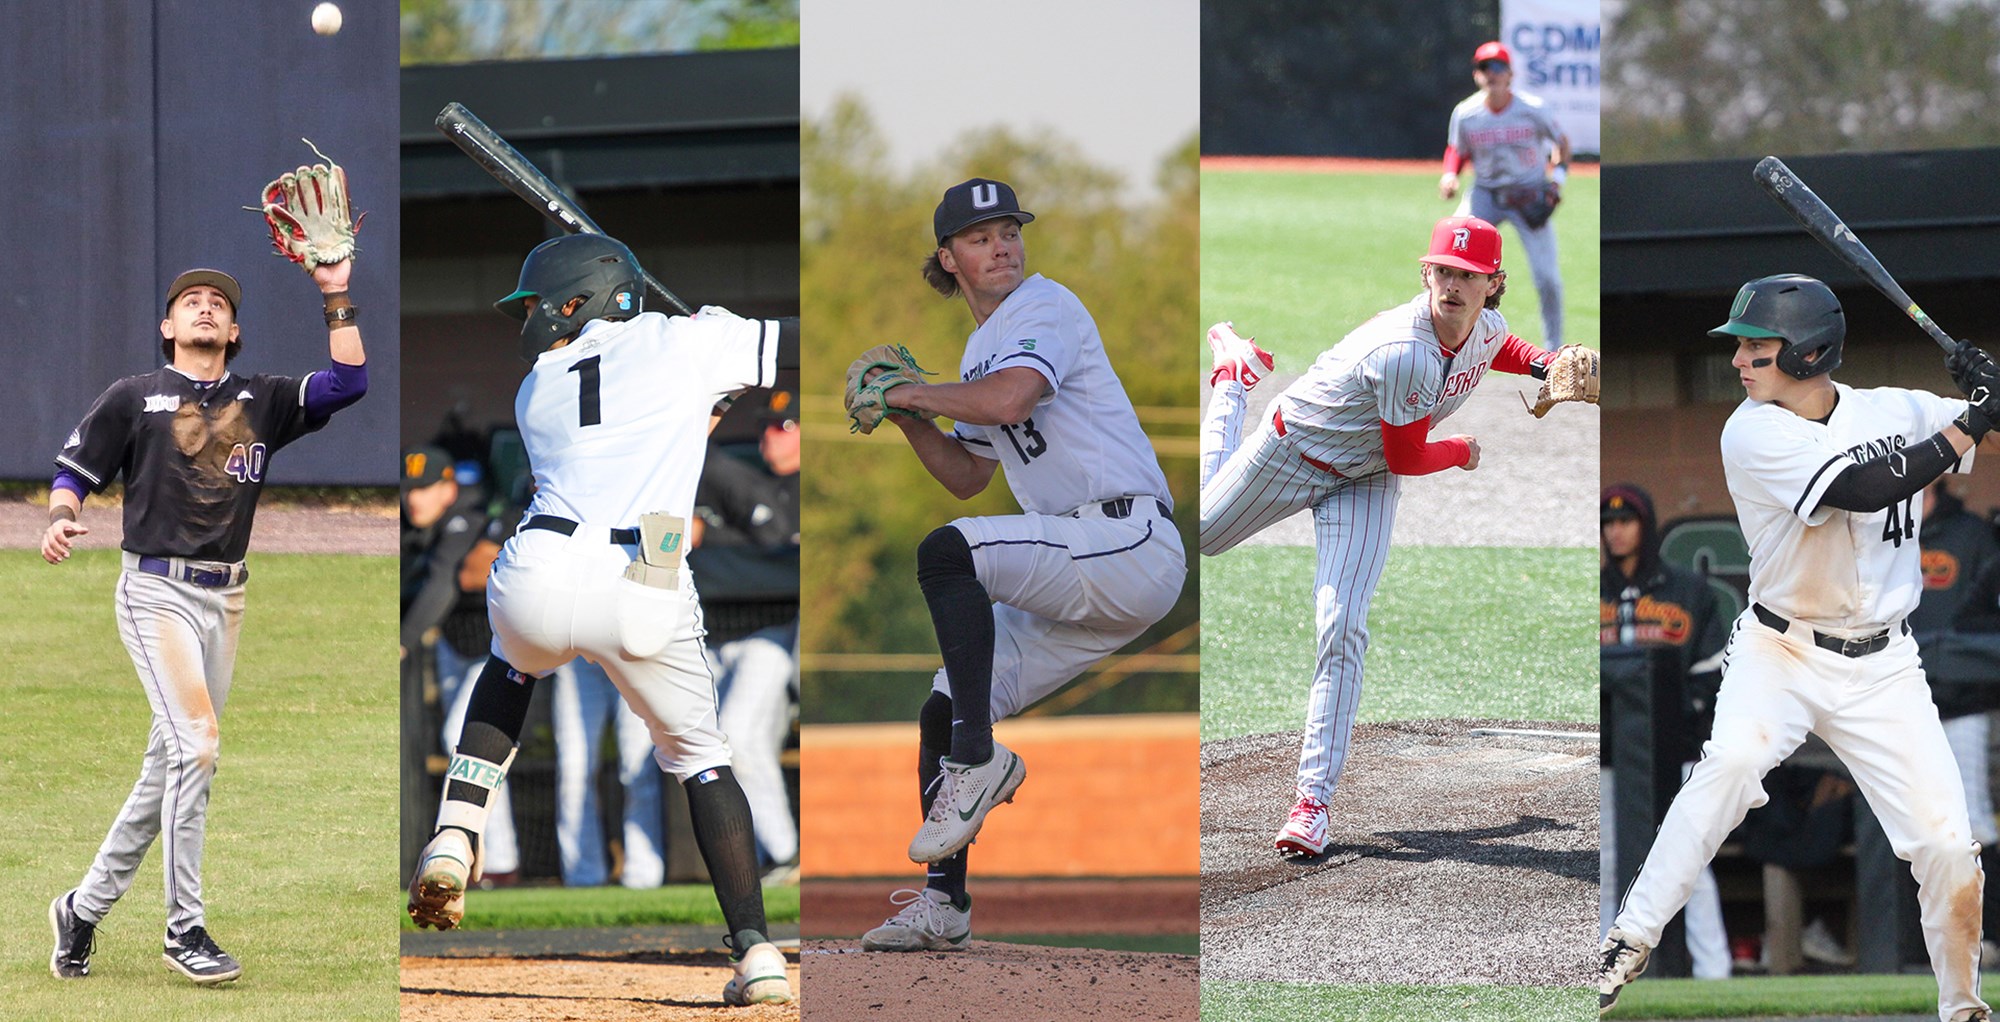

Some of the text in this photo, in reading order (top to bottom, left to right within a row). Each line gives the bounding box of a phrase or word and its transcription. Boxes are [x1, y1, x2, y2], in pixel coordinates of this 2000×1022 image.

[971, 183, 1000, 210] U
[1452, 227, 1471, 252] R
[1729, 283, 1756, 321] U
[567, 354, 602, 428] 1
[1000, 417, 1047, 466] 13
[1842, 434, 1906, 466] TANS
[223, 442, 266, 483] 40
[659, 531, 682, 553] U
